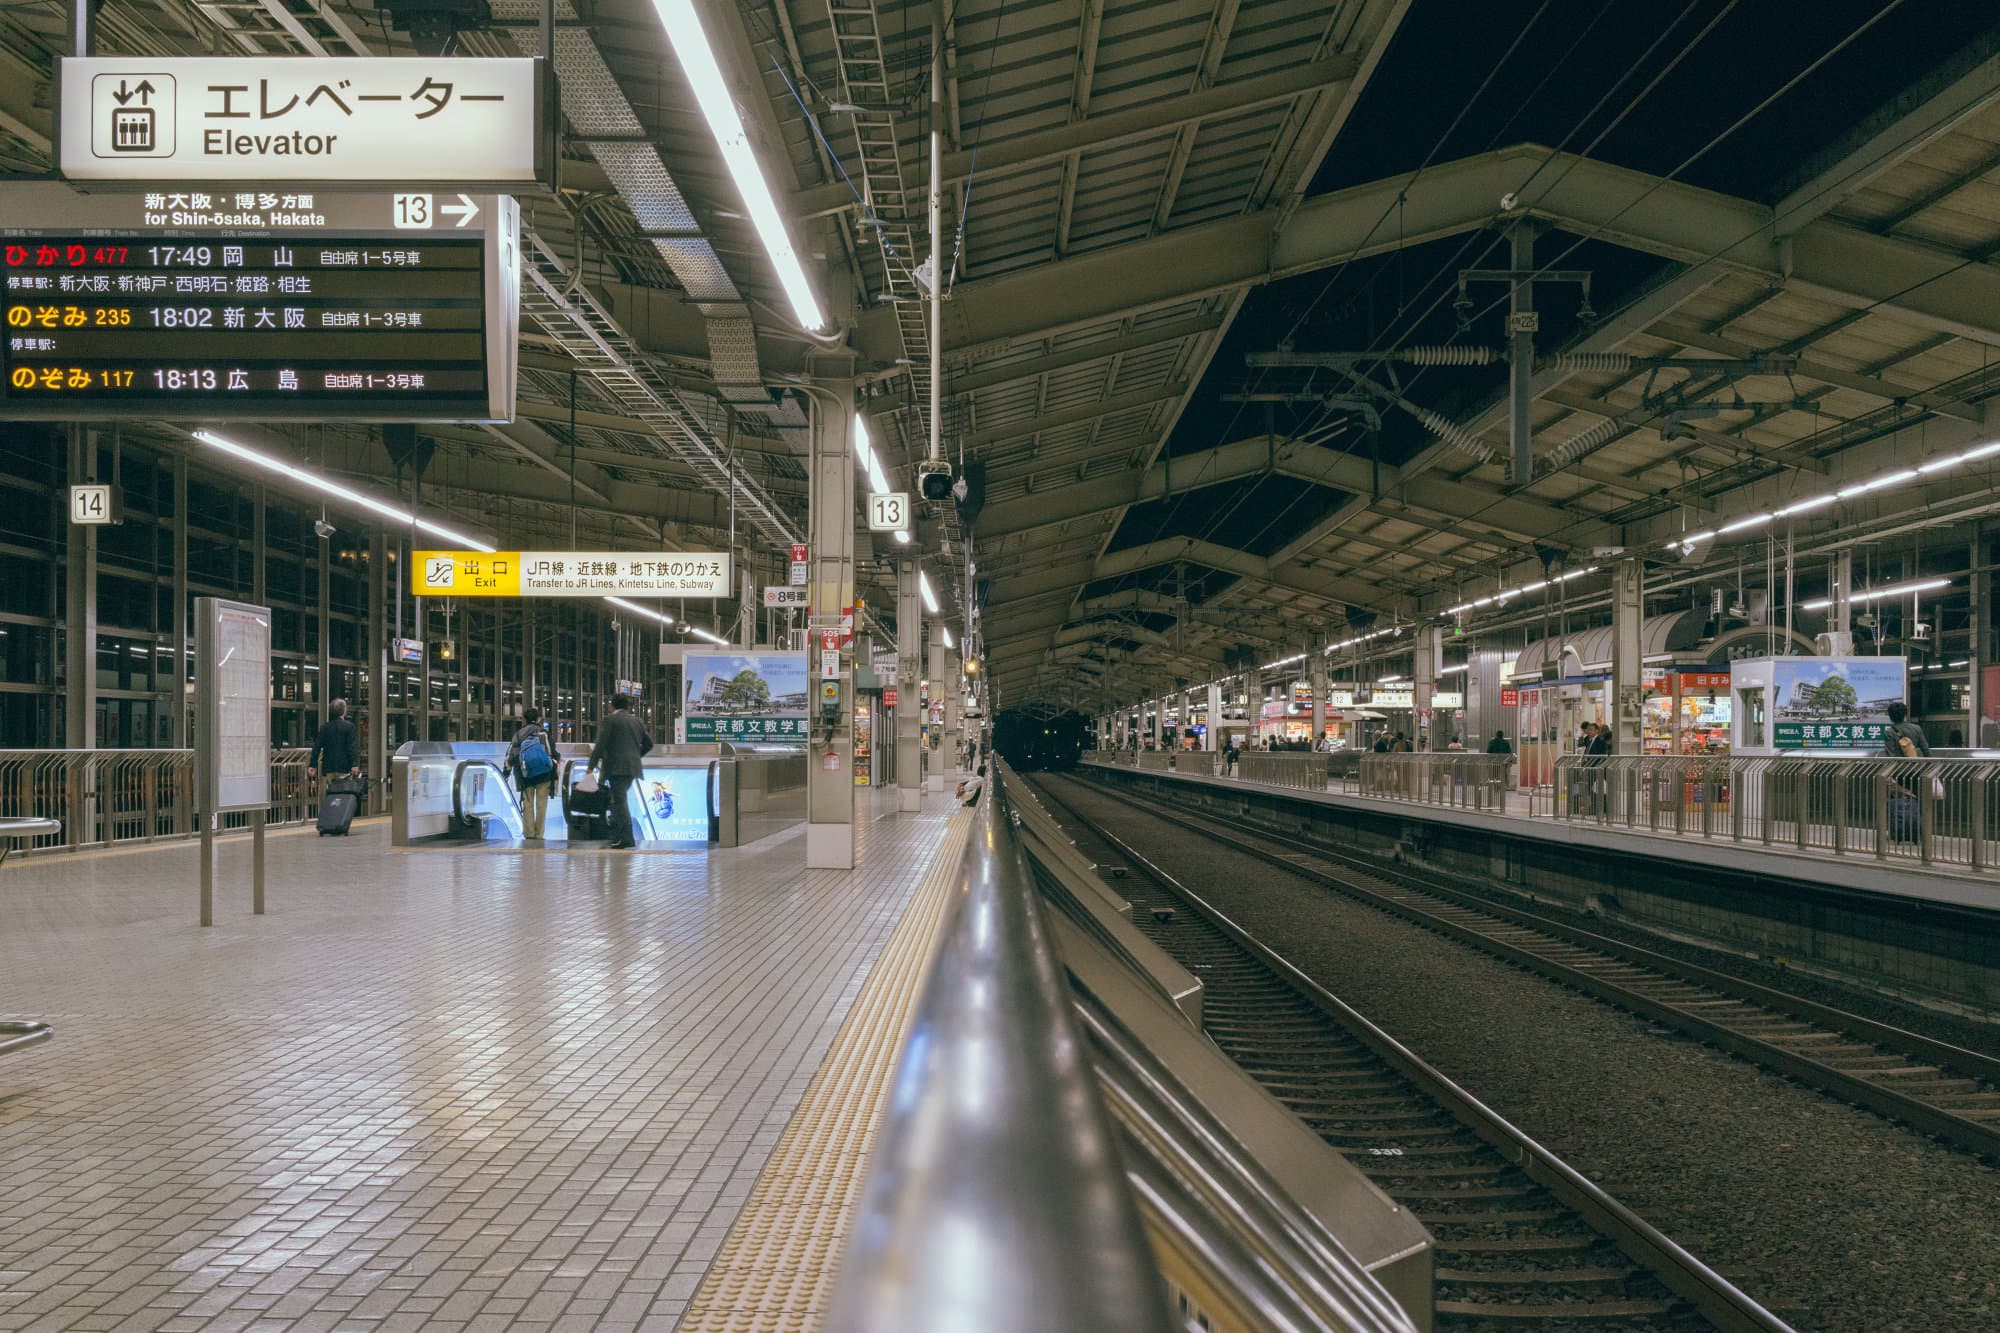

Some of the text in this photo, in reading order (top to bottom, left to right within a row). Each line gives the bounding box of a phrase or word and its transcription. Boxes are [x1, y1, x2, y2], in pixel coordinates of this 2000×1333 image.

[204, 77, 505, 120] エレベーター
[203, 129, 337, 156] Elevator
[145, 212, 325, 227] for Shin-ōsaka, Hakata
[397, 196, 427, 224] 13
[5, 244, 87, 266] ひかり
[93, 247, 128, 264] 477
[148, 246, 212, 266] 17:49
[8, 305, 88, 327] のぞみ
[96, 309, 131, 325] 235
[150, 307, 213, 328] 18:02
[223, 307, 306, 328] 新大阪
[12, 367, 92, 389] のぞみ
[101, 371, 134, 387] 117
[153, 369, 217, 390] 18:13
[79, 492, 103, 516] 14
[876, 500, 900, 523] 13
[464, 560, 508, 576] 出口
[475, 577, 497, 588] Exit
[528, 579, 564, 589] Transfer
[565, 580, 575, 589] to
[576, 579, 589, 589] JR
[618, 579, 655, 589] Kintetsu
[680, 579, 714, 591] Subway
[778, 591, 807, 603] 8号車
[1336, 696, 1344, 704] 12
[714, 720, 808, 733] 京都文教学園
[1802, 726, 1891, 739] 京都文教学
